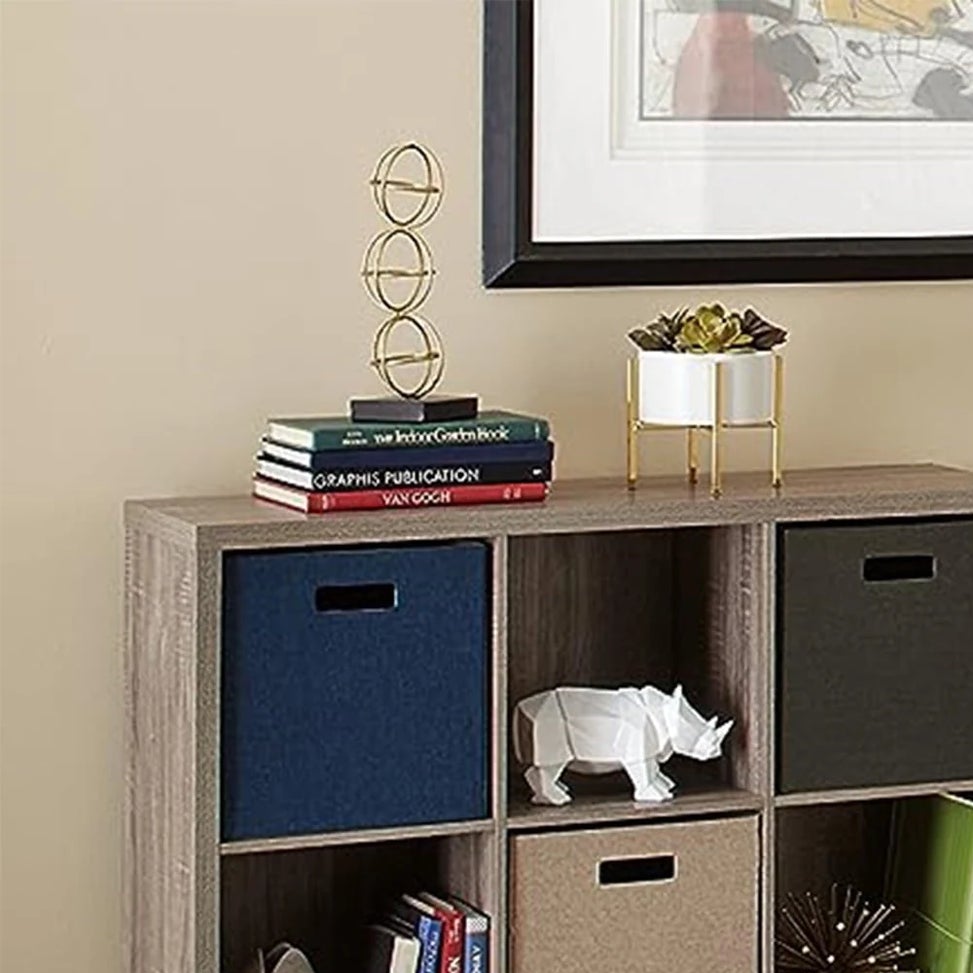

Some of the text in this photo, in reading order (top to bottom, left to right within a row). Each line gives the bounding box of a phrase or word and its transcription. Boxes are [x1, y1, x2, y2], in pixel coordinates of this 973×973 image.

[434, 426, 475, 441] Garden
[313, 467, 480, 489] GRAPHIS PUBLICATION
[382, 490, 451, 506] VAN GOGH
